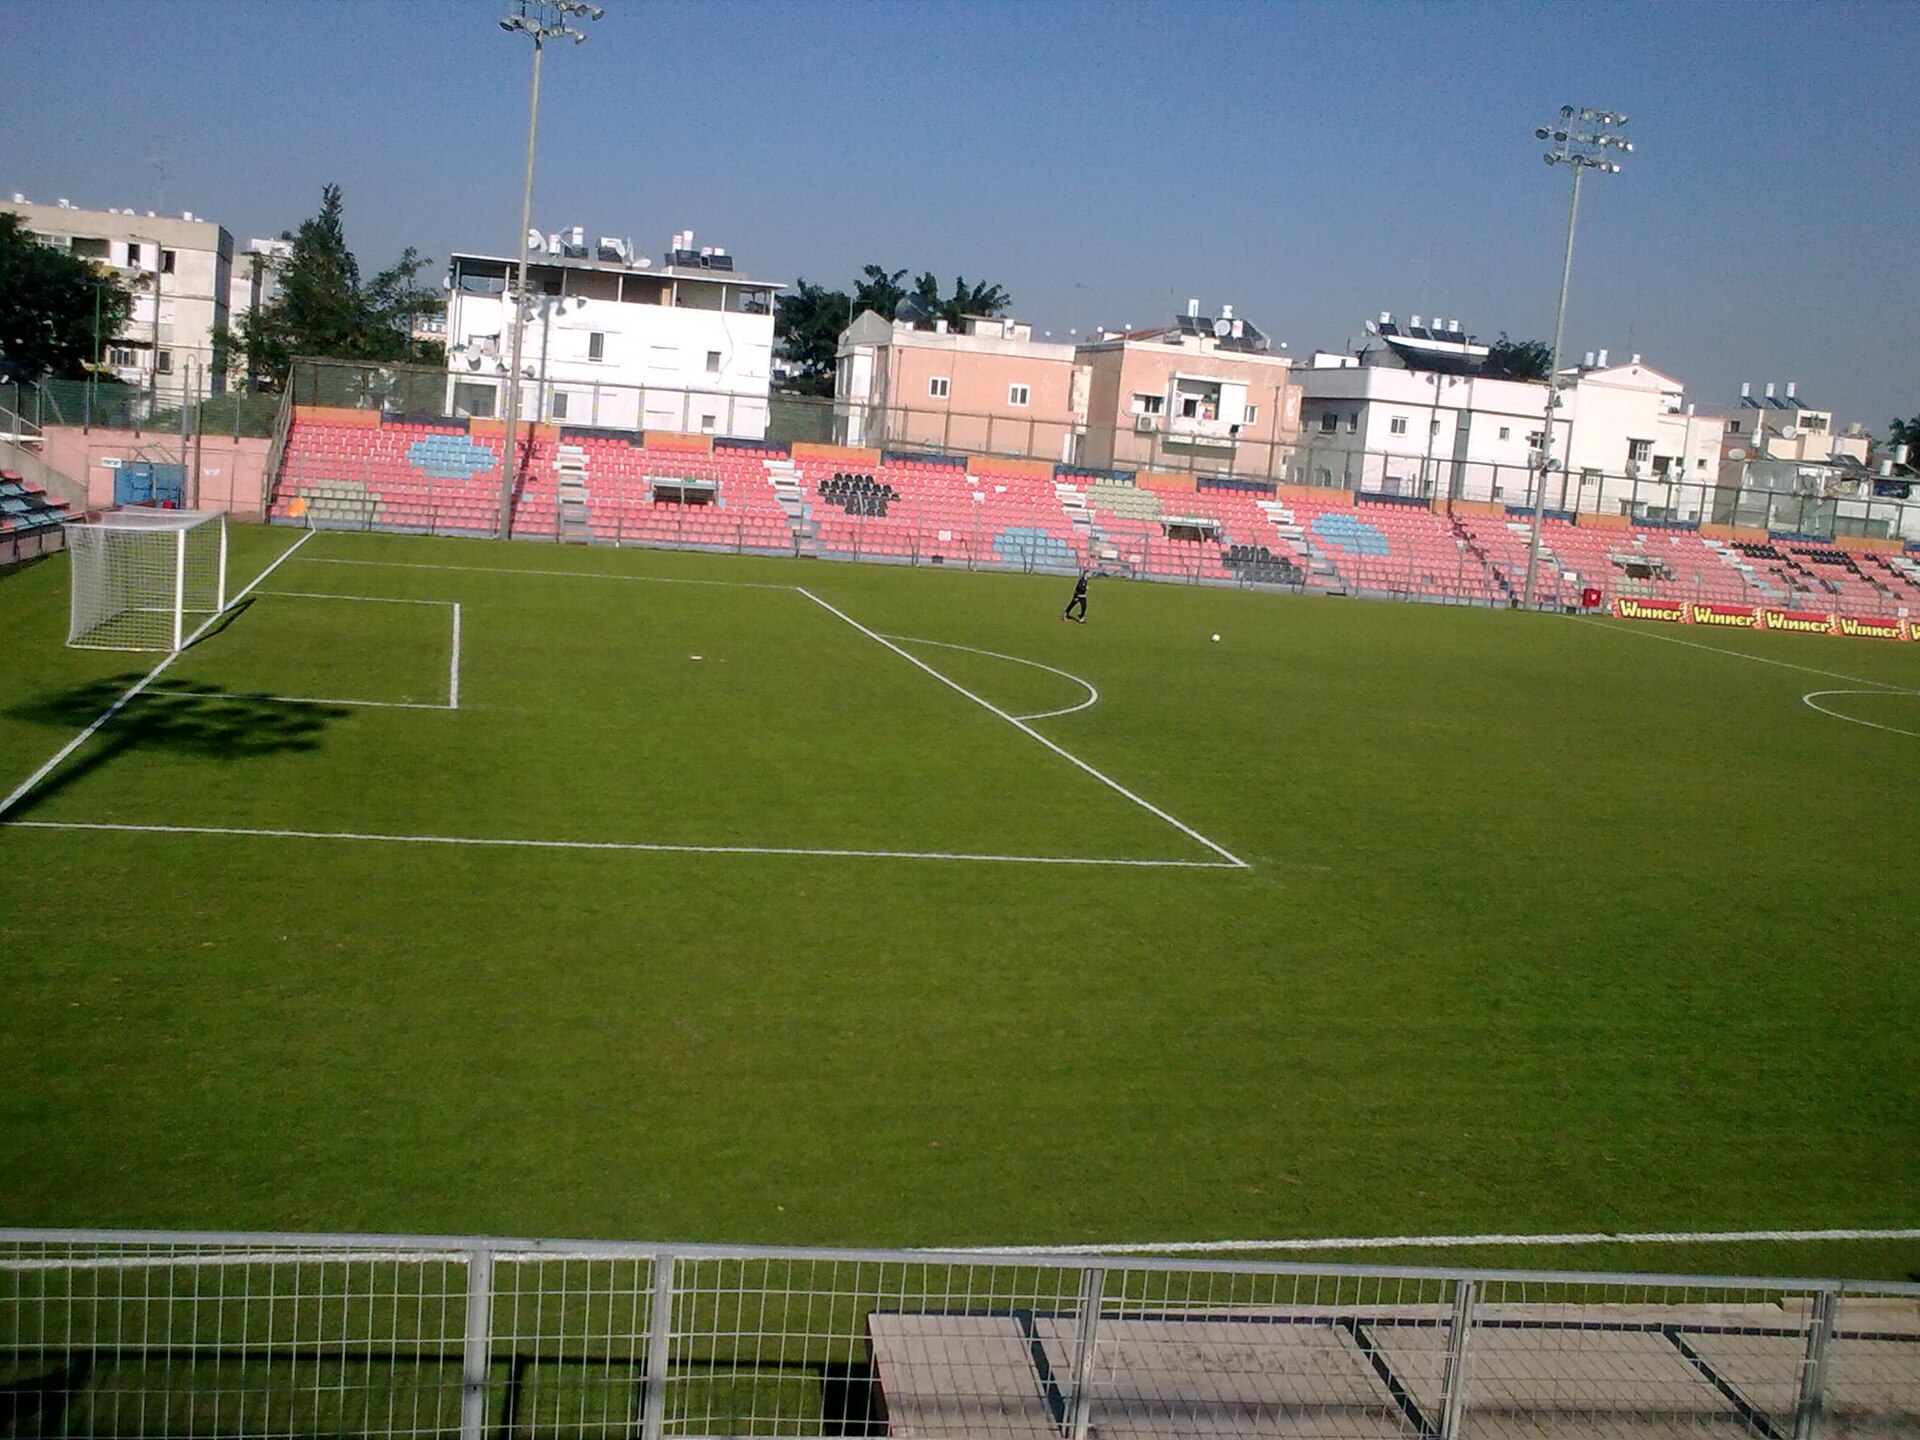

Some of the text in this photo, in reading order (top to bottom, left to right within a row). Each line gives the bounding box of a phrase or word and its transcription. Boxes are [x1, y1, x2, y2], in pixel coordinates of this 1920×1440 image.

[1619, 600, 1682, 622] Winner
[1693, 605, 1755, 627] Winner
[1766, 611, 1830, 633] Winner
[1841, 618, 1900, 638] Winner
